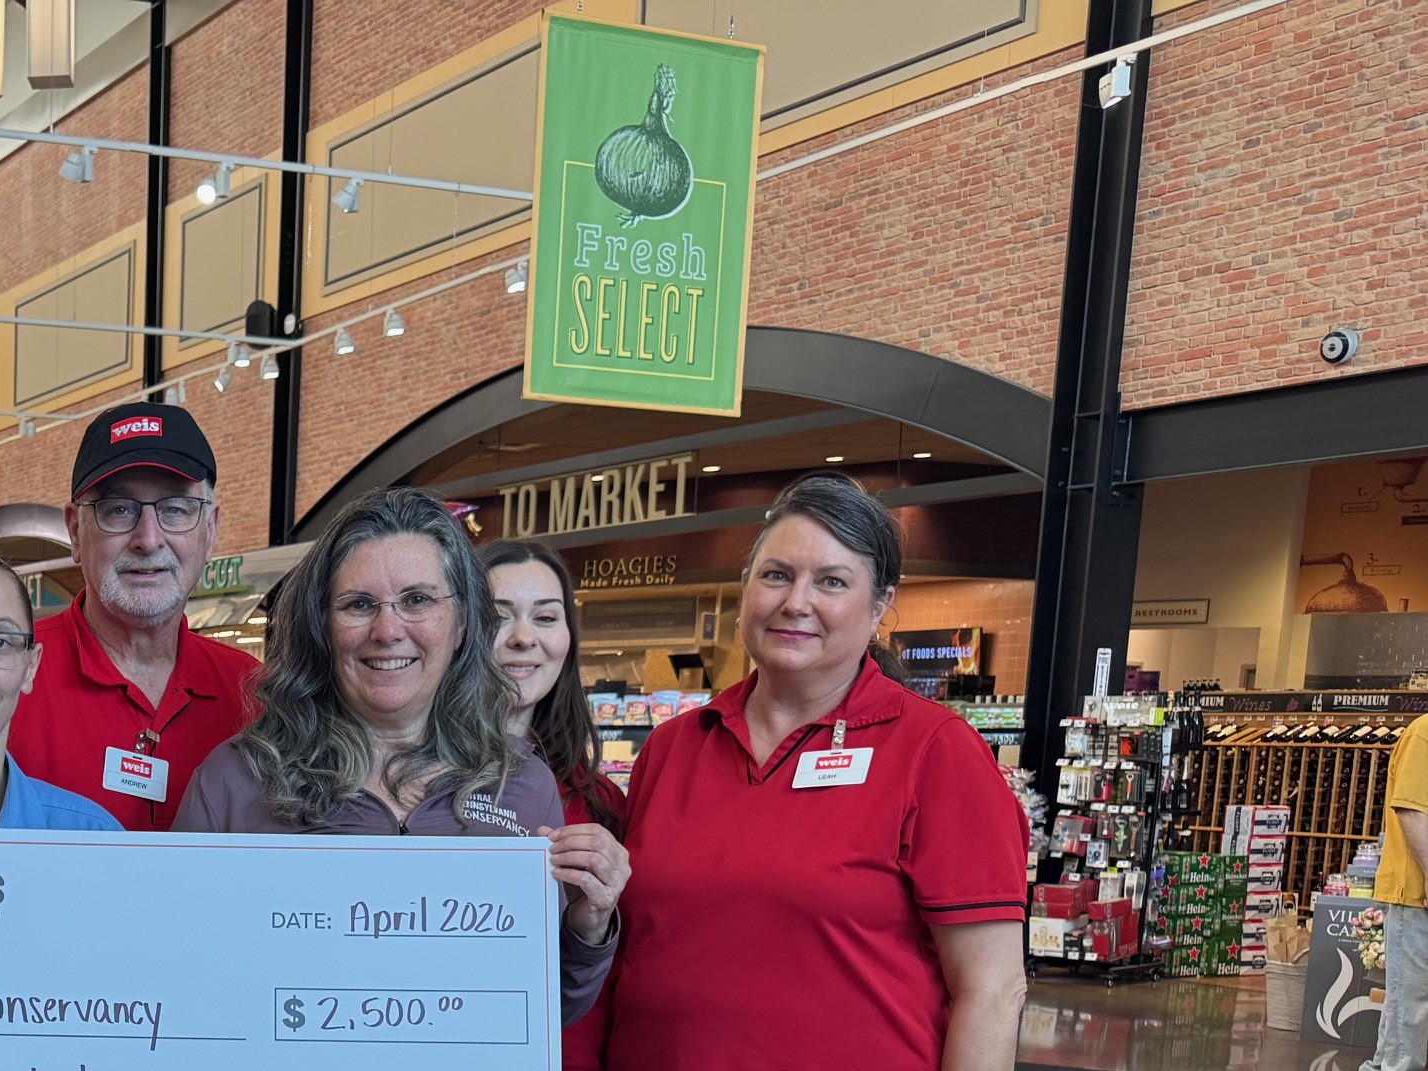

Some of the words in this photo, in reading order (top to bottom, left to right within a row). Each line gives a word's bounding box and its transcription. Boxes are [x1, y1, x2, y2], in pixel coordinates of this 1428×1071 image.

[574, 222, 707, 281] Fresh
[569, 272, 704, 365] SELECT
[112, 418, 160, 437] weis
[499, 483, 537, 539] TO
[548, 456, 693, 534] MARKET
[202, 556, 243, 589] CUT
[584, 555, 677, 577] HOAGIES
[580, 578, 608, 588] Made
[612, 575, 641, 586] Fresh
[646, 574, 675, 585] Daily
[1135, 608, 1198, 617] RESTROOMS
[912, 647, 935, 659] FOODS
[936, 646, 972, 659] SPECIALS
[1230, 697, 1272, 711] Wines
[1333, 695, 1390, 706] PREMIUM
[123, 761, 150, 775] weis
[818, 757, 850, 767] weis
[121, 778, 147, 789] ANDREW
[272, 912, 332, 930] DATE:
[350, 896, 427, 939] April
[439, 898, 515, 933] 2026
